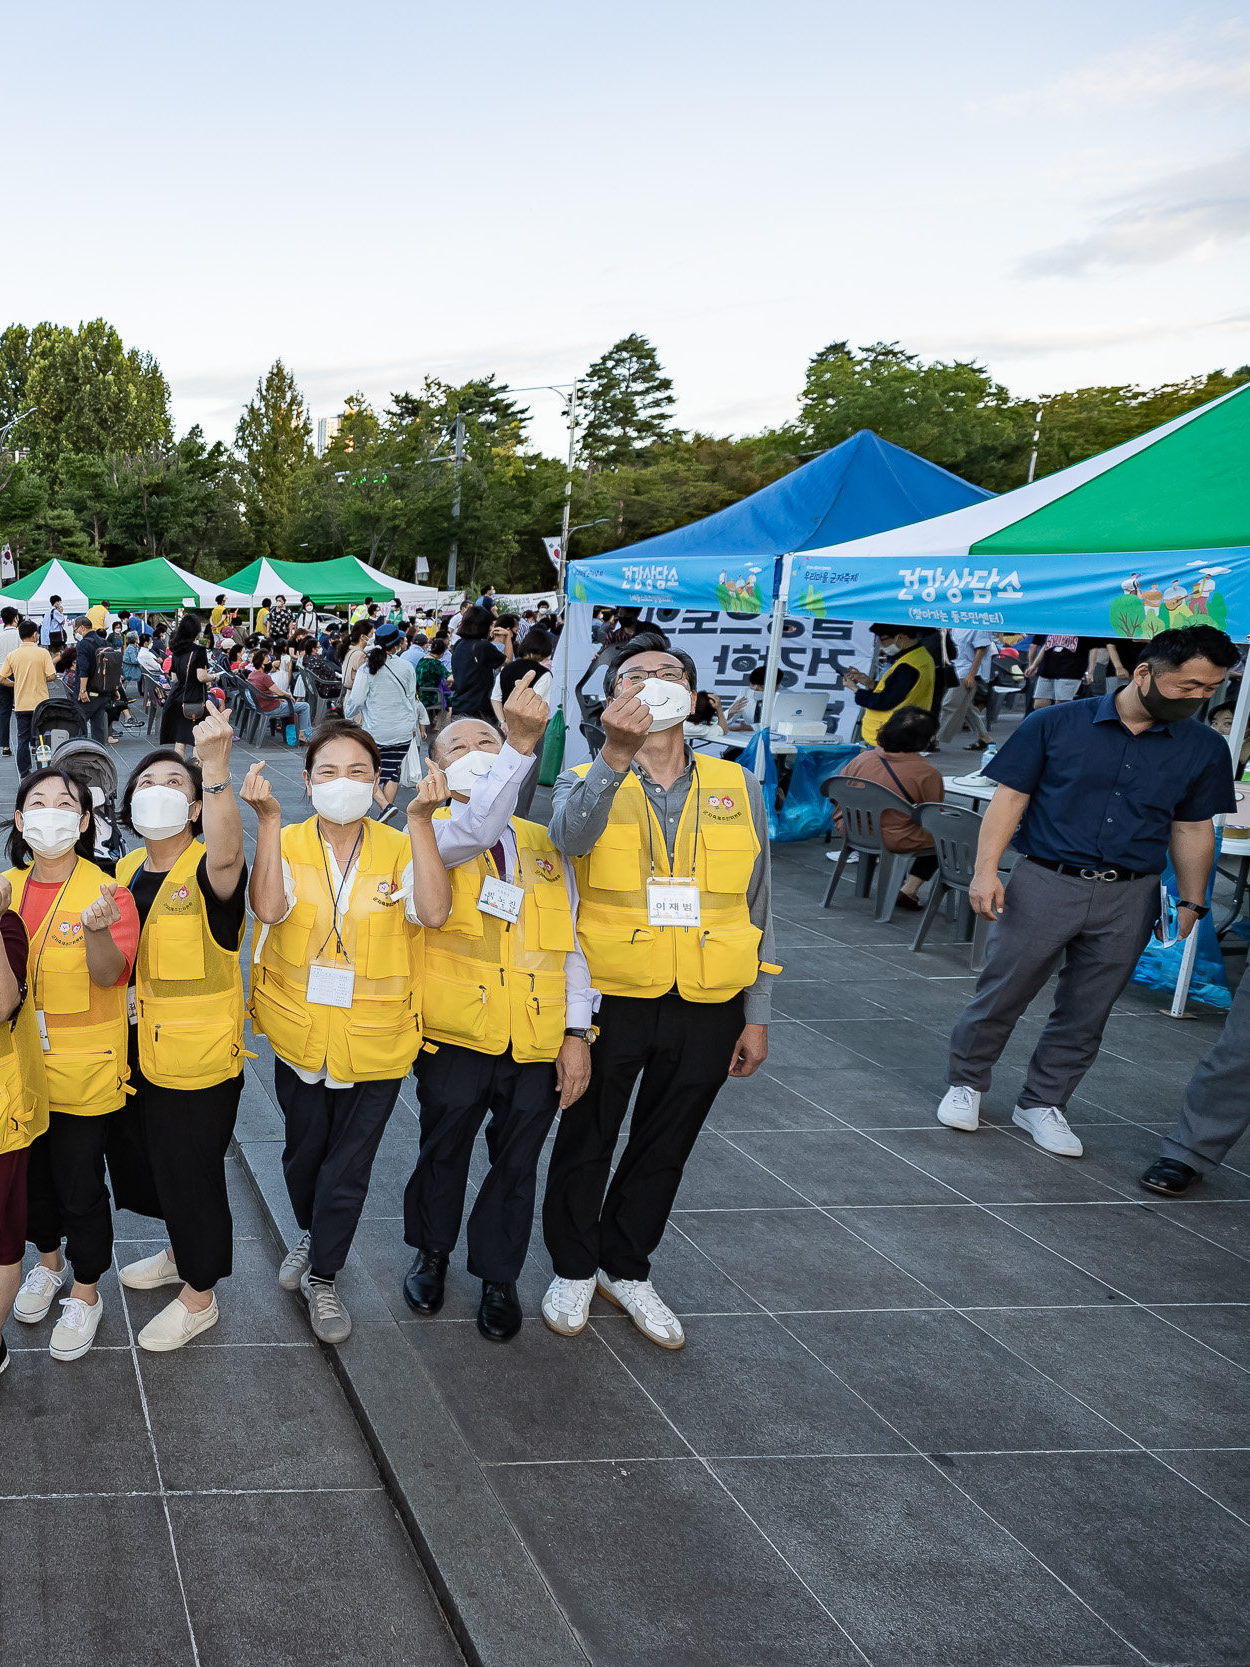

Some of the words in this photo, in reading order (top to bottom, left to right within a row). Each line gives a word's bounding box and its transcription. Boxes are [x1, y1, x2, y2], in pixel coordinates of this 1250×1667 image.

[622, 565, 679, 590] 건강상담소
[804, 571, 829, 584] 우리마을
[898, 567, 1024, 604] 건강상담소
[908, 607, 949, 623] (찾아가는
[951, 610, 1005, 626] 동주민센터)
